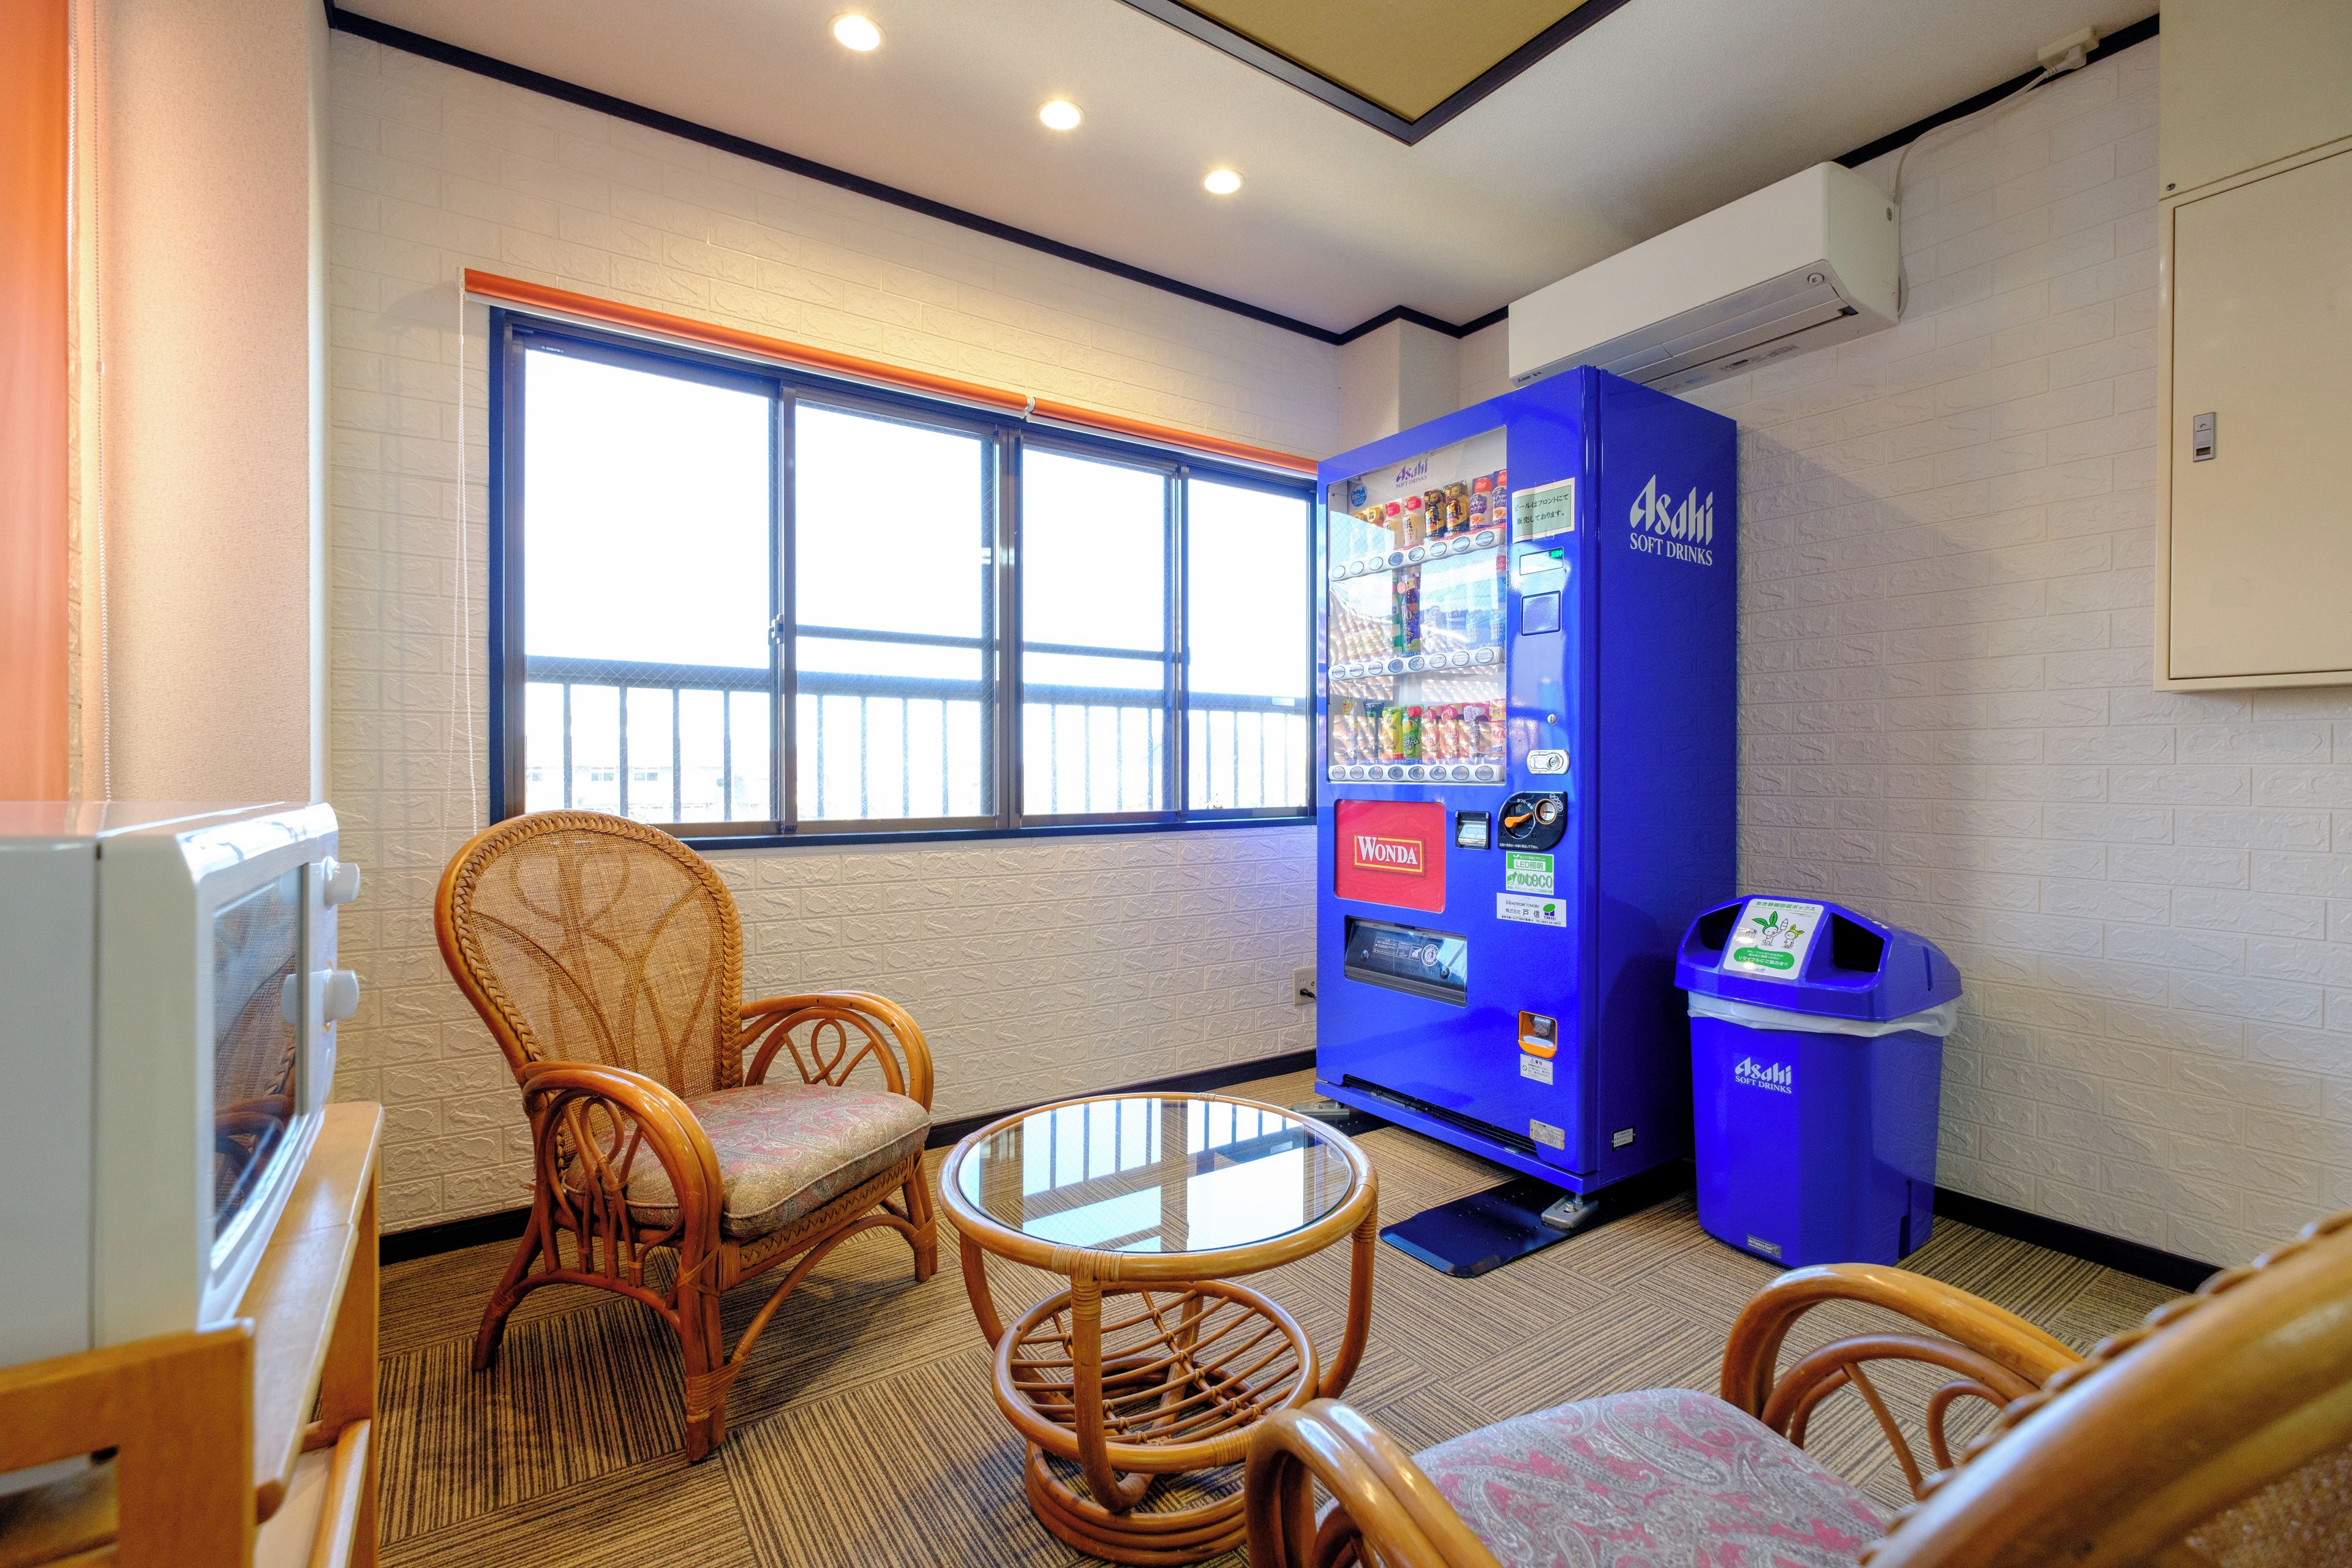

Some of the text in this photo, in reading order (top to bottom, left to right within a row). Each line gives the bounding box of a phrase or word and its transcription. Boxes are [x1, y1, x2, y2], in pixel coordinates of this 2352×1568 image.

[1396, 457, 1428, 483] Asahi
[1396, 475, 1428, 489] SOFT DRINKS
[1515, 493, 1569, 511] ビールはフロントにて
[1630, 474, 1713, 546] Asahi
[1517, 510, 1564, 525] 販売しております。
[1630, 532, 1713, 567] SOFT DRINKS
[1357, 835, 1418, 864] WONDA
[1516, 861, 1544, 870] LED照明
[1517, 873, 1553, 888] のむeco
[1755, 901, 1815, 911] あき容器回収ボックス
[1735, 1057, 1791, 1085] Asahi
[1735, 1075, 1792, 1093] SOFT DRINKS
